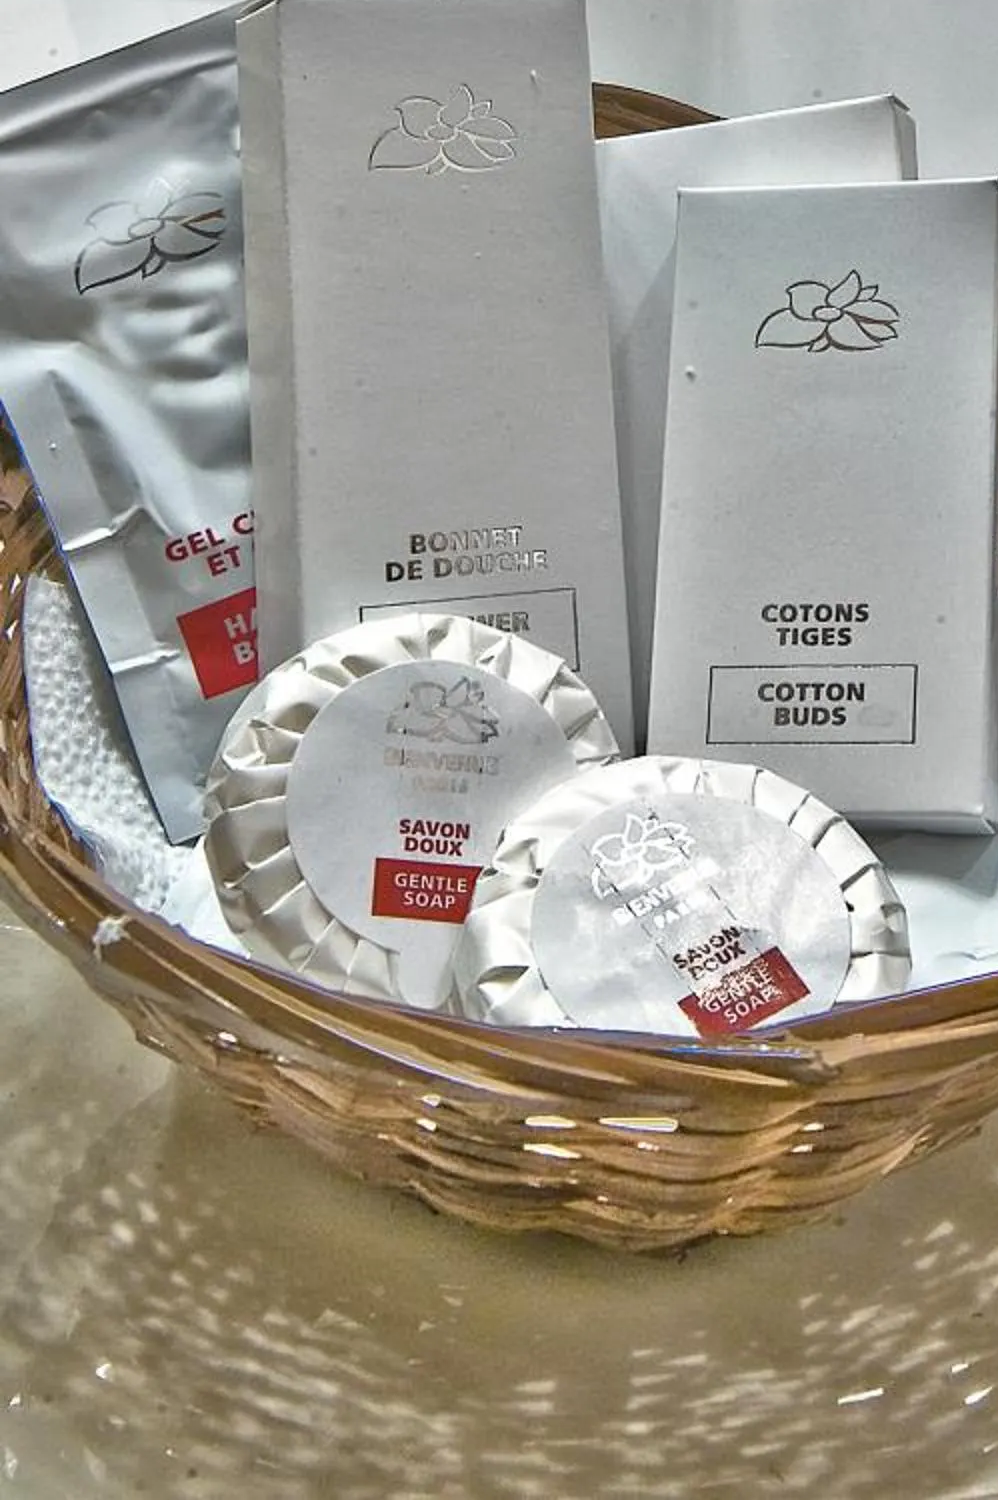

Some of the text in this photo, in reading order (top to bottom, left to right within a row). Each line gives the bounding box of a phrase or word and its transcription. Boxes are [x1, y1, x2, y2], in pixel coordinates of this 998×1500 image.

[165, 528, 225, 562] GEL
[410, 525, 523, 555] BONNET
[207, 545, 241, 576] ET
[385, 550, 549, 582] DE DOUCHE
[761, 604, 869, 623] COTONS
[776, 627, 852, 646] TIGES
[757, 683, 866, 702] COTTON
[773, 707, 847, 727] BUDS
[399, 819, 471, 840] SAVON
[404, 837, 464, 857] DOUX
[394, 872, 469, 893] GENTLE
[403, 890, 456, 910] SOAP
[672, 925, 742, 969] SAVON
[704, 963, 775, 1014] GENTLE
[723, 987, 783, 1025] SOAP
